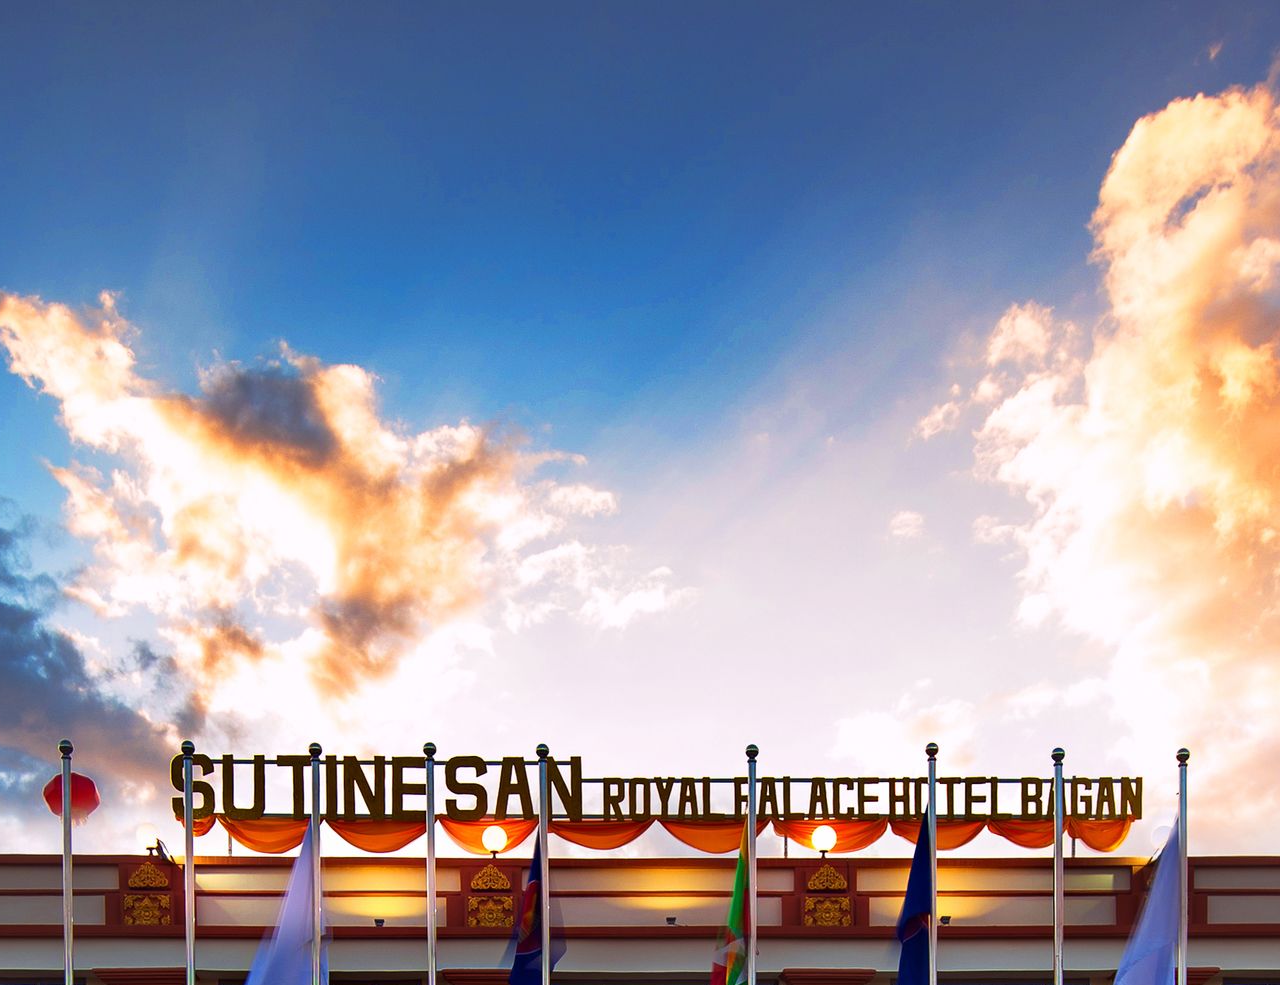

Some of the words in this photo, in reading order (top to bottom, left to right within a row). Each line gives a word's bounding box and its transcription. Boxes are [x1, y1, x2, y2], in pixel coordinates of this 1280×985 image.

[444, 755, 583, 823] SAN
[603, 777, 725, 821] ROYAL
[1020, 776, 1143, 821] BAGAN
